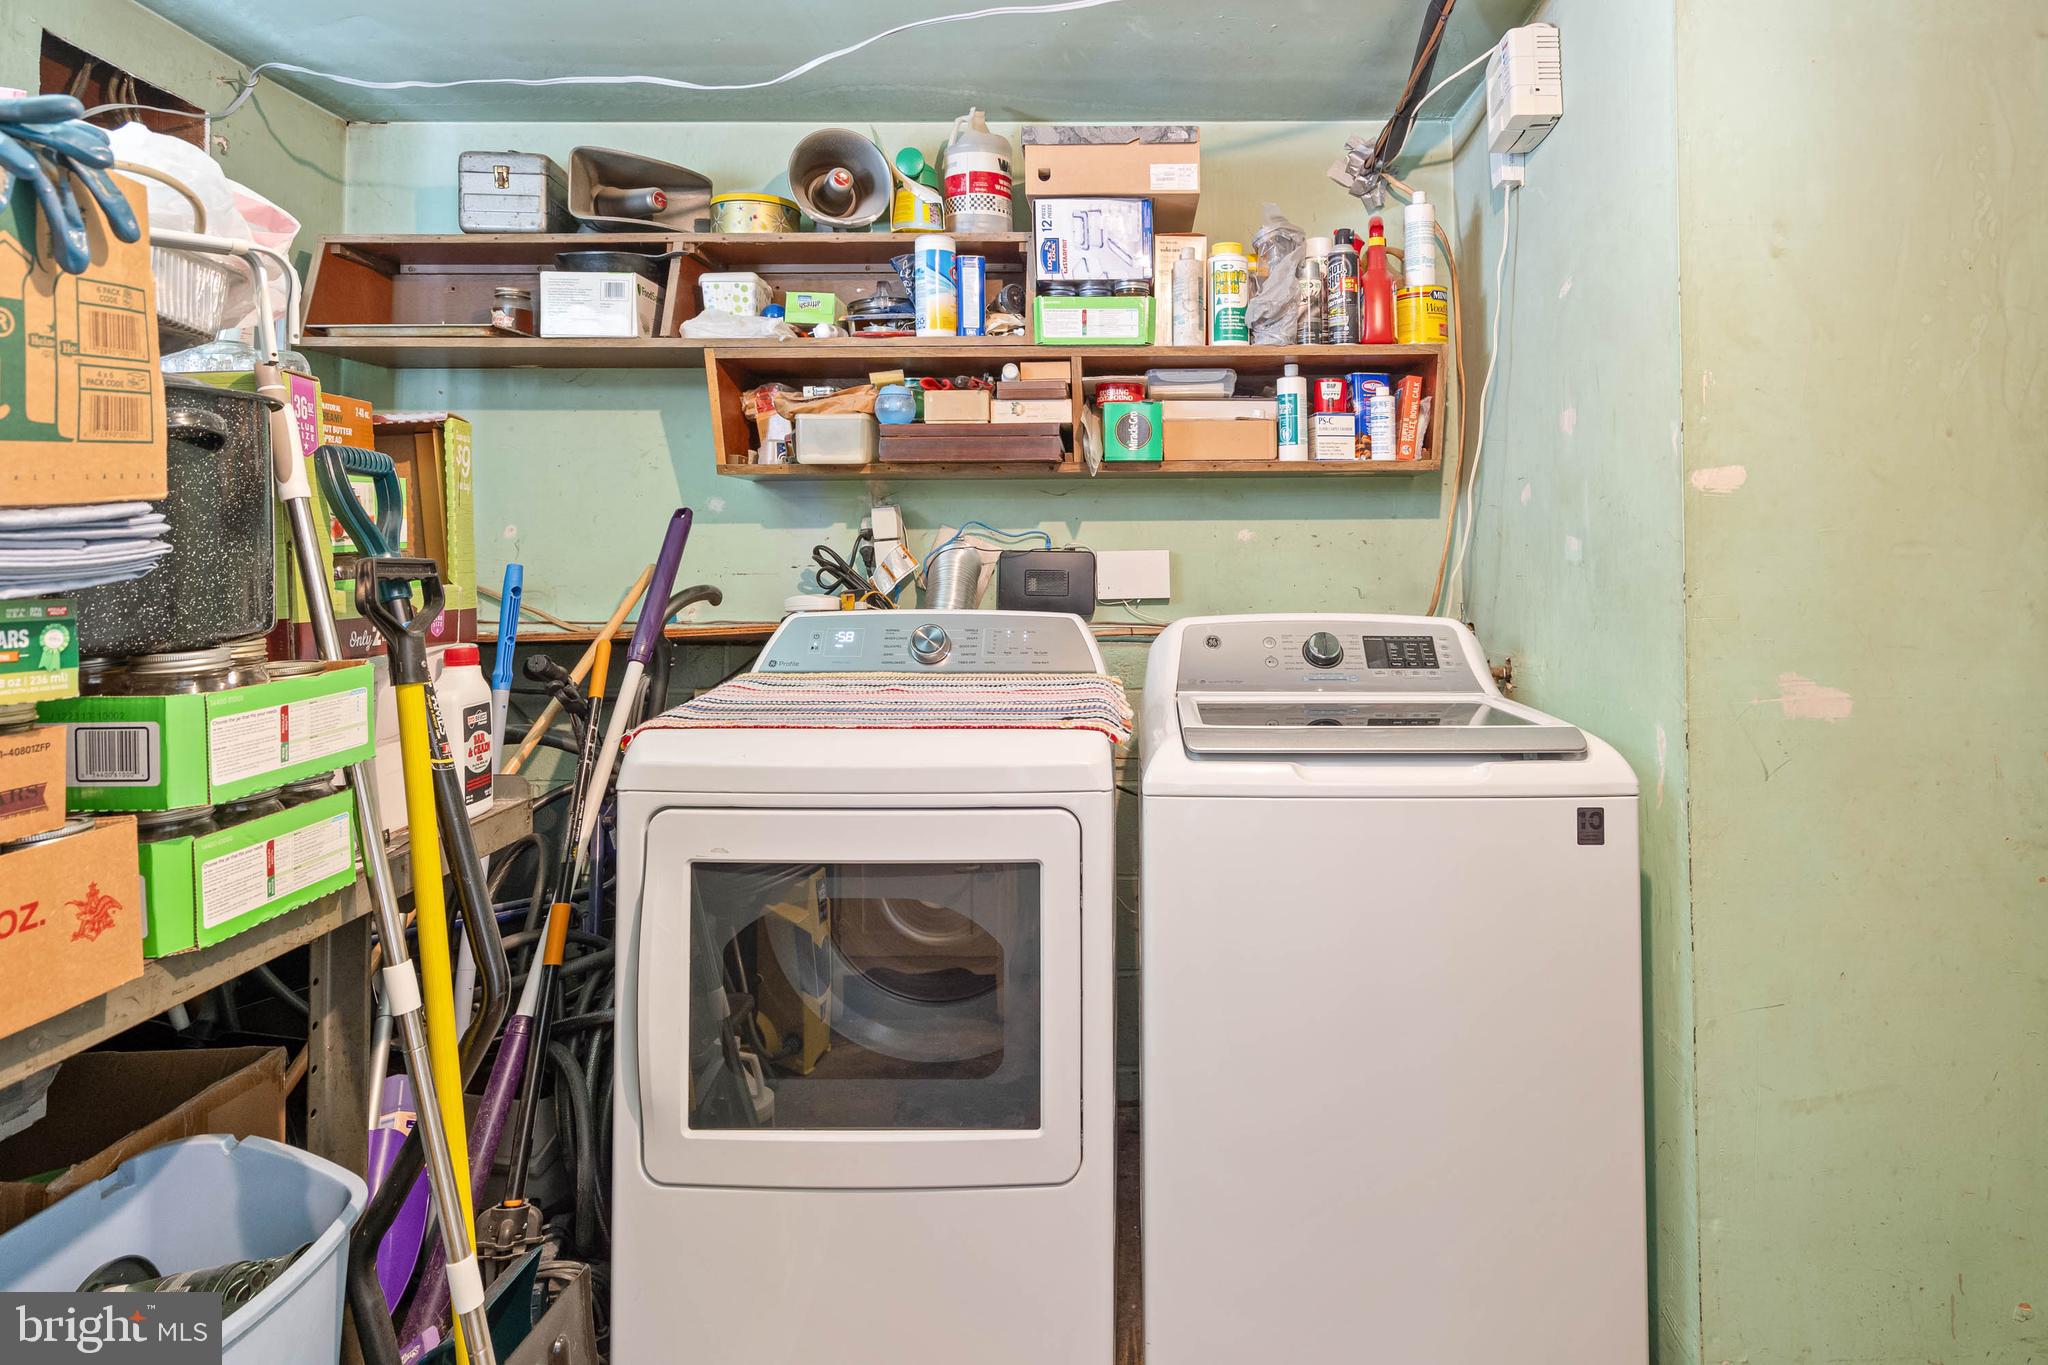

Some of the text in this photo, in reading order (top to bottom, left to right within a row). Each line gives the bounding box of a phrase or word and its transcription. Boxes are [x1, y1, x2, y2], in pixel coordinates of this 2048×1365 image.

[1042, 220, 1052, 232] 12
[104, 287, 120, 296] PACK
[100, 294, 118, 304] CODE
[86, 378, 124, 388] PACK CODE
[294, 394, 308, 420] 36
[1410, 401, 1418, 418] BOWL
[323, 411, 344, 423] REAMY
[301, 430, 314, 442] IZE
[332, 426, 352, 436] BUTTER
[1408, 421, 1418, 442] TOILET
[324, 435, 342, 444] PREAD
[350, 630, 372, 652] Only
[473, 732, 485, 745] BAR
[474, 741, 490, 756] CHAIN
[0, 901, 46, 940] OZ.
